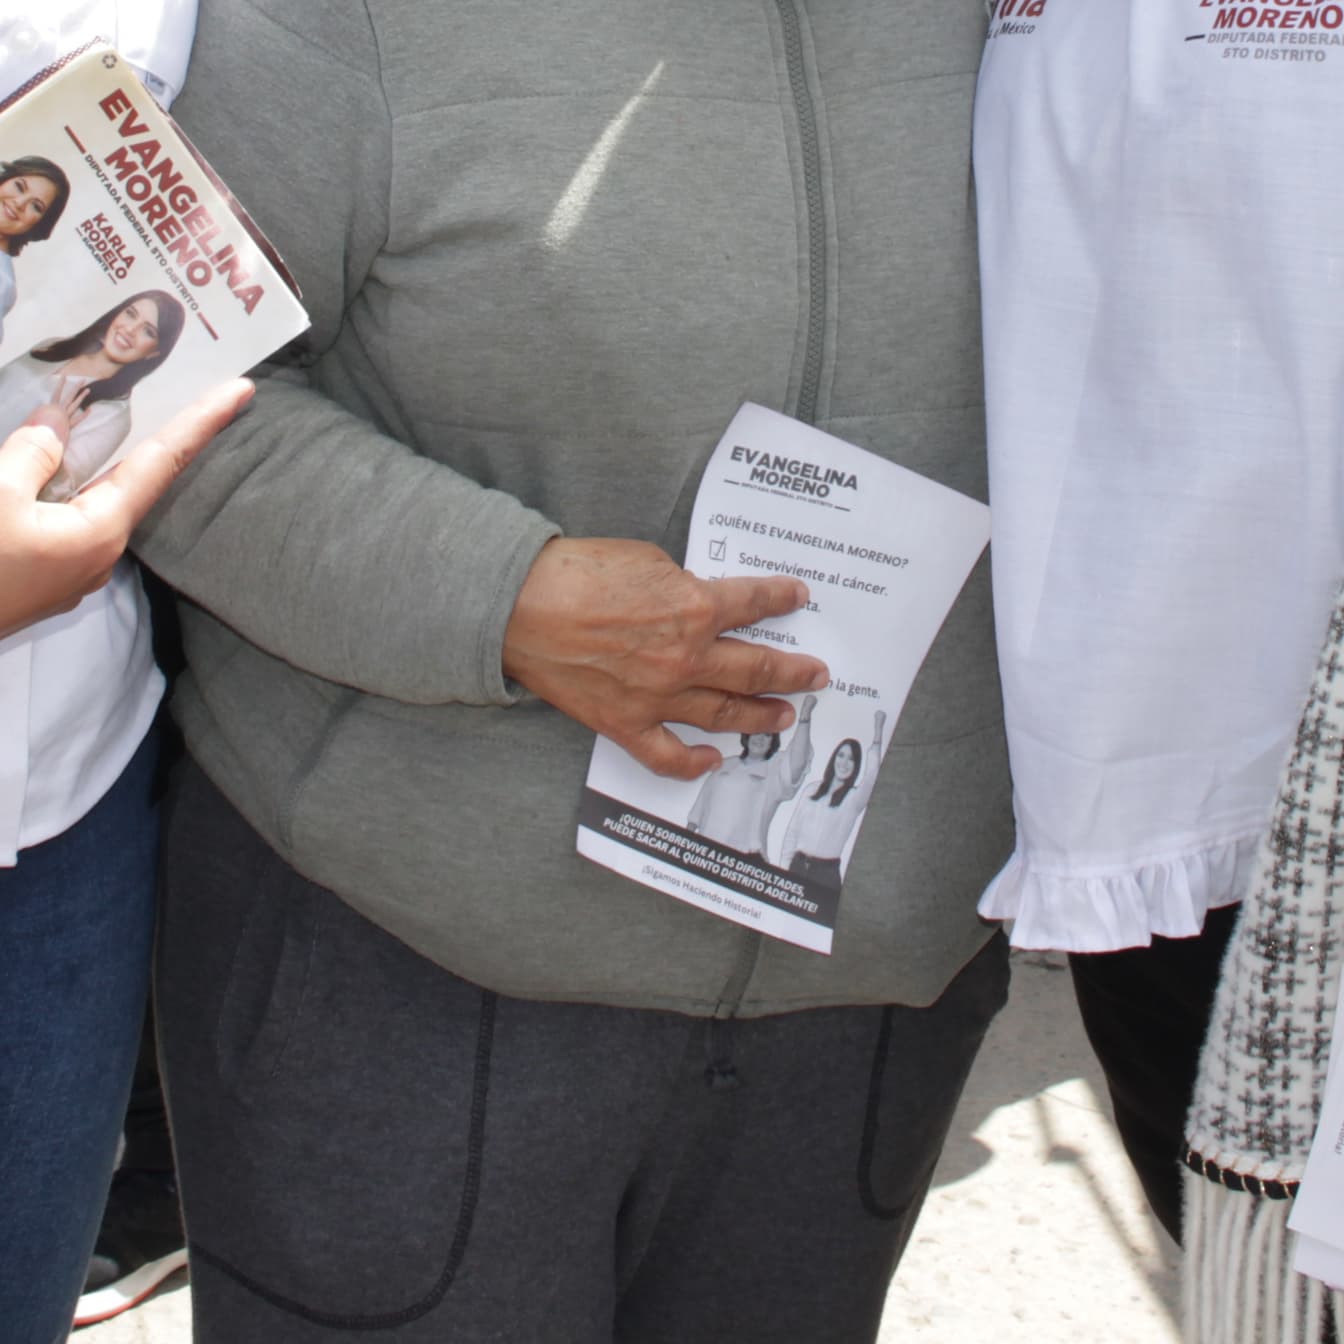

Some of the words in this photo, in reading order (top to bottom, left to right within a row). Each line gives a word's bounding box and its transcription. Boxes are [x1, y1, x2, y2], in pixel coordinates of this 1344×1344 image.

[1207, 31, 1276, 44] DIPUTADA
[1212, 4, 1344, 30] MORENO
[1222, 47, 1250, 59] 5TO
[1253, 47, 1327, 63] DISTRITO
[96, 85, 271, 316] EVANGELINA
[102, 144, 218, 292] MORENO
[78, 216, 130, 283] RODELO
[80, 235, 110, 274] SUPLENTE
[82, 152, 123, 205] DIPUTADA
[118, 202, 154, 248] FEDERAL
[163, 264, 200, 313] DISTRITO
[90, 210, 138, 271] KARLA
[728, 444, 860, 491] EVANGELINA
[748, 466, 831, 499] MORENO
[707, 510, 753, 532] ¿QUIÉN
[751, 521, 768, 535] ES
[767, 524, 846, 554] EVANGELINA
[845, 544, 909, 570] MORENO?
[736, 550, 826, 583] Sobreviviente
[826, 571, 841, 585] al
[840, 574, 890, 597] cáncer.
[834, 677, 848, 692] la
[846, 681, 882, 701] gente.
[601, 816, 637, 840] PUEDE
[634, 830, 670, 854] SACAR
[666, 844, 683, 859] AL
[680, 850, 721, 875] QUINTO
[719, 866, 765, 893] DISTRITO
[763, 883, 819, 914] ADELANTE!
[653, 826, 709, 858] SOBREVIVE
[707, 848, 717, 861] A
[714, 852, 736, 869] LAS
[680, 879, 724, 905] Haciendo
